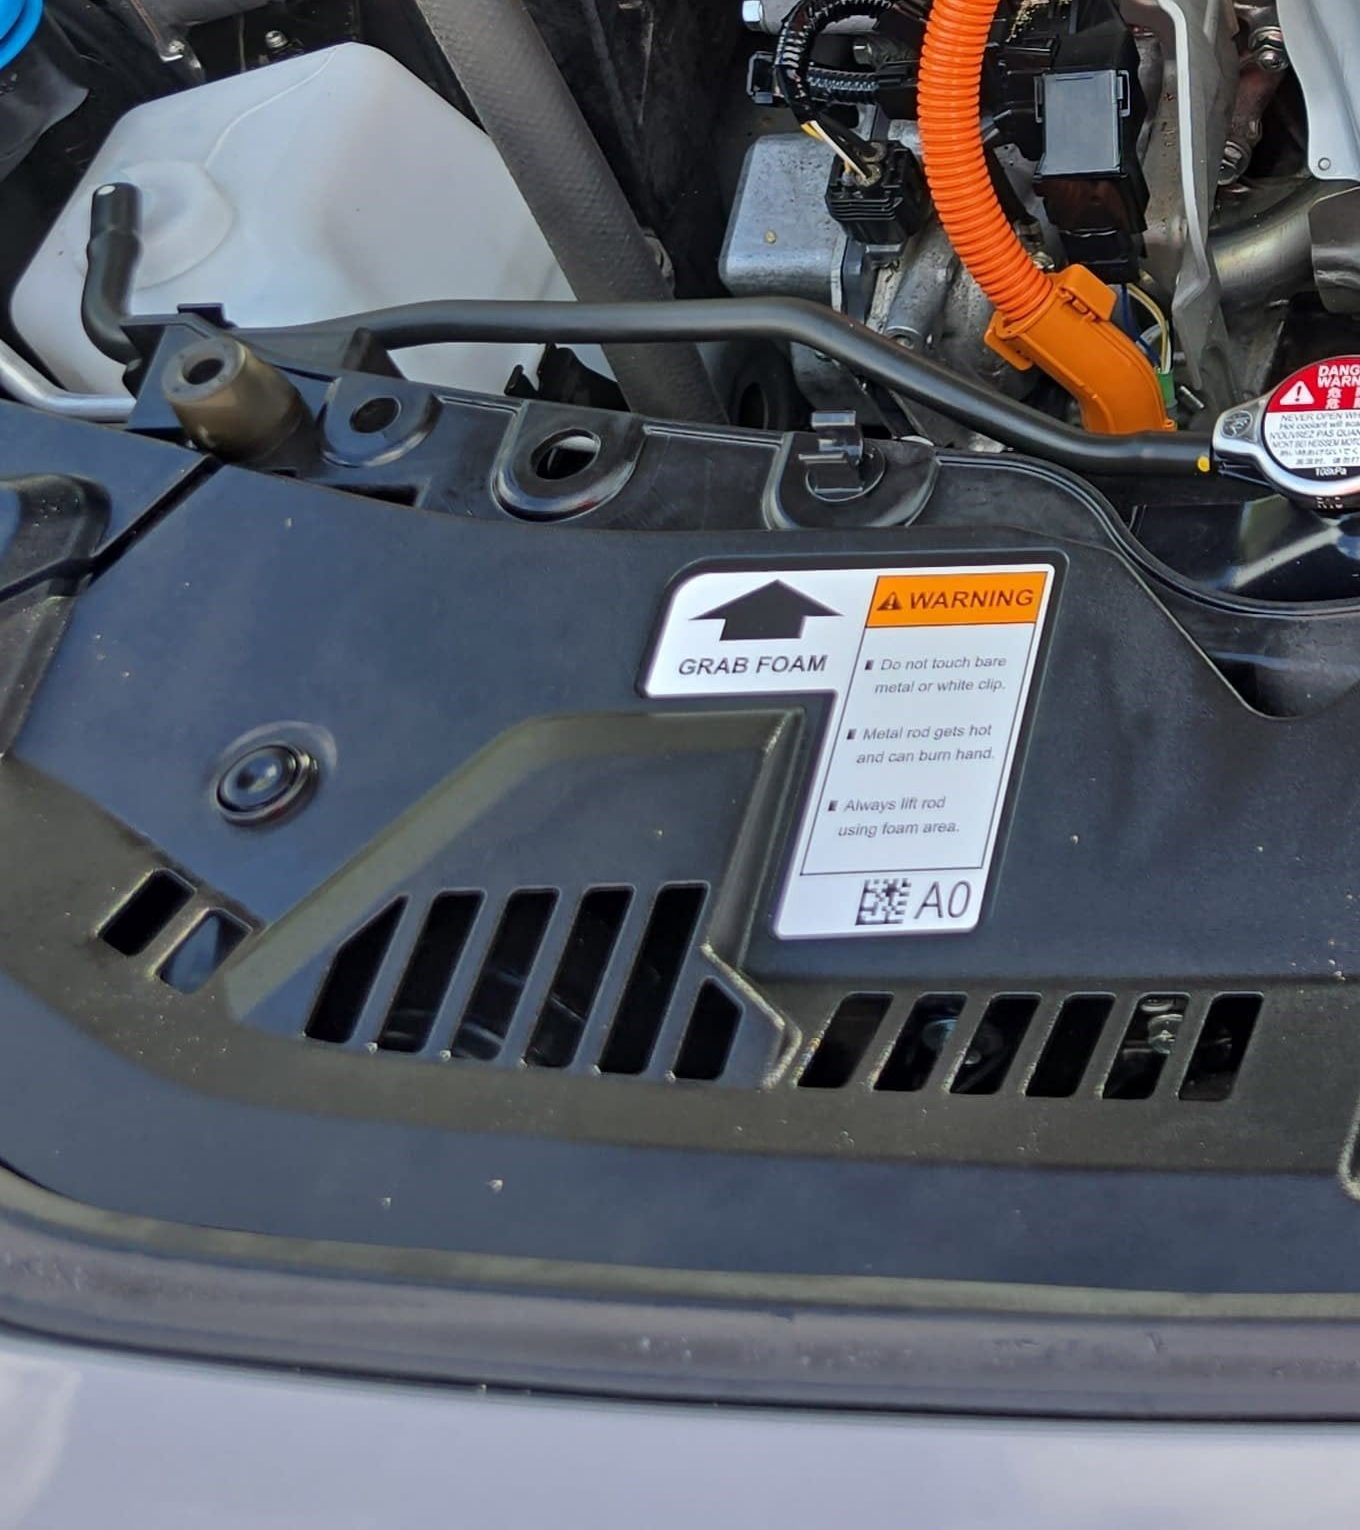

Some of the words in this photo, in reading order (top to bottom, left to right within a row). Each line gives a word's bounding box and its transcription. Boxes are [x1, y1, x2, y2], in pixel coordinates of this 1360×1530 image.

[1281, 413, 1313, 422] NEVER
[1316, 412, 1342, 420] OPEN
[1279, 422, 1294, 430] Hot
[1316, 429, 1334, 437] PAS
[910, 589, 1034, 608] WARNING
[678, 657, 750, 676] GRAB
[756, 655, 828, 673] FOAM
[881, 658, 900, 671] Do
[905, 658, 928, 670] not
[932, 656, 971, 669] touch
[975, 655, 1007, 668] bare
[874, 680, 914, 694] metal
[917, 683, 932, 692] or
[936, 679, 975, 692] white
[979, 678, 1007, 694] clip.
[863, 727, 902, 740] Metal
[906, 726, 930, 739] rod
[934, 726, 963, 742] gets
[967, 724, 993, 737] hot
[856, 751, 885, 764] and
[888, 753, 914, 763] can
[919, 748, 952, 762] burn
[955, 747, 995, 761] hand.
[844, 798, 896, 814] Always
[901, 797, 918, 810] lift
[921, 796, 946, 810] rod
[838, 823, 877, 840] using
[881, 821, 918, 835] foam
[922, 821, 960, 834] area.
[914, 880, 972, 920] A0
